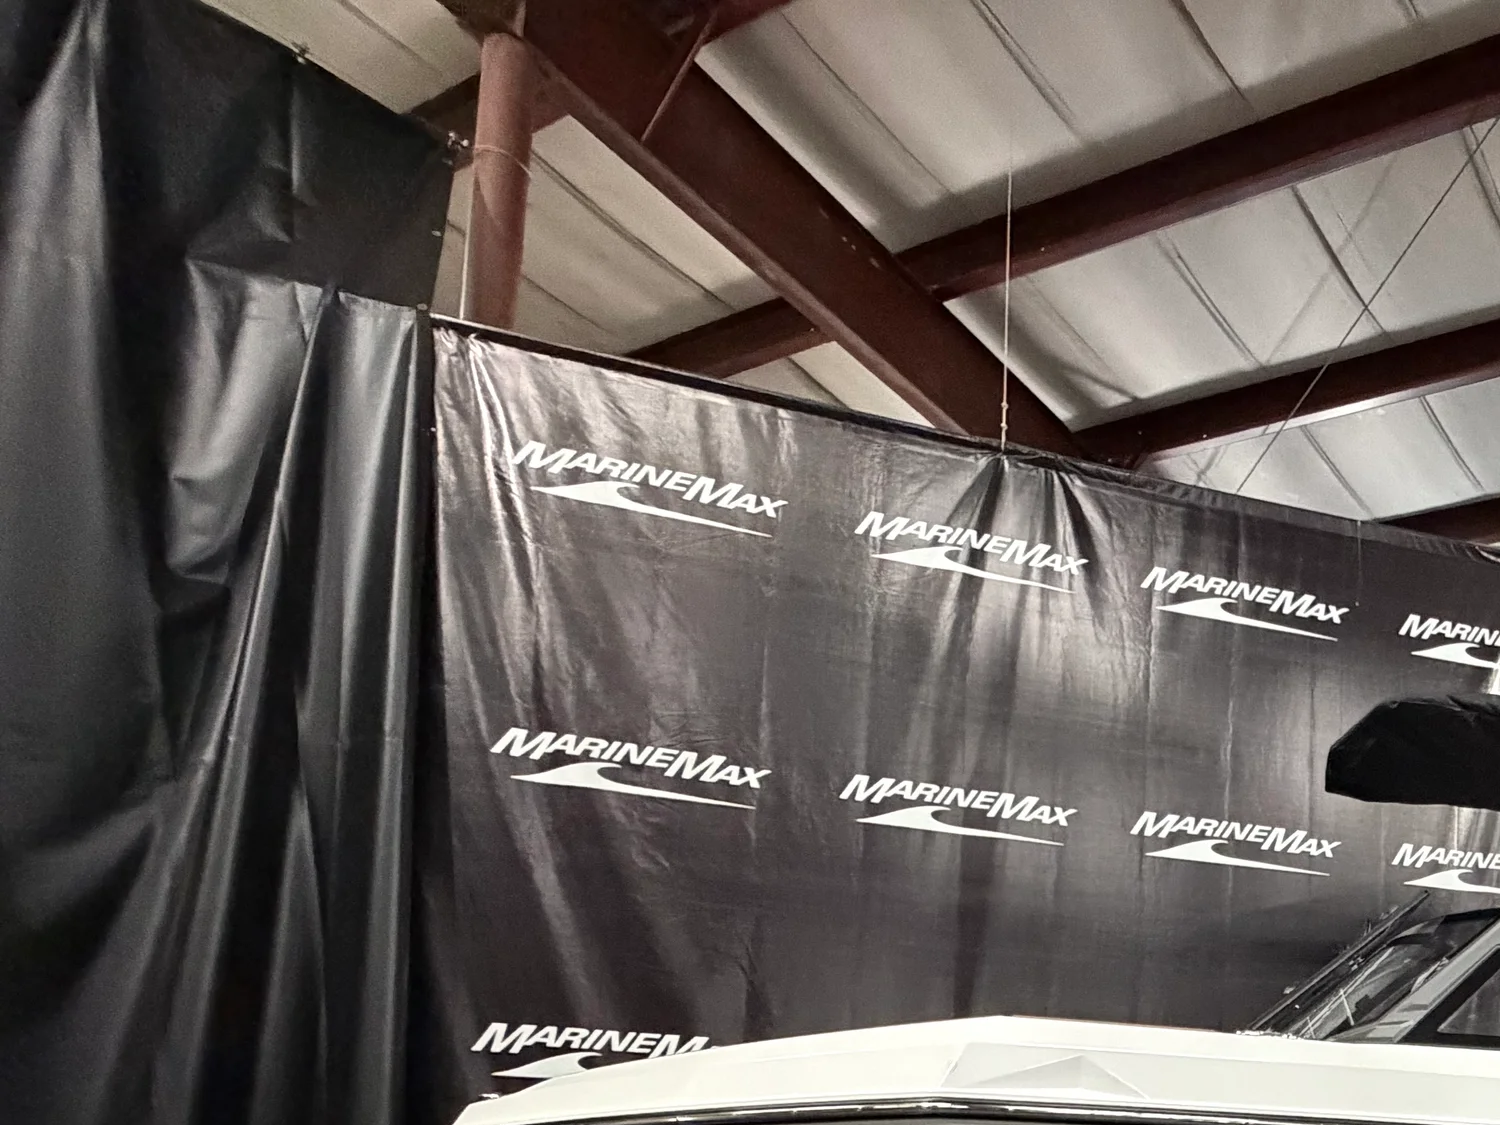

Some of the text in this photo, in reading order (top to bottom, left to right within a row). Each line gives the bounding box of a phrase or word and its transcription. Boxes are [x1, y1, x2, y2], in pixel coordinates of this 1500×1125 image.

[511, 439, 788, 519] MARINEMAX
[854, 511, 1088, 576] MARINEMAX
[1140, 566, 1350, 626] MARINEMAX
[490, 727, 772, 790] MARINEMAX
[839, 773, 1078, 828] MARINEMAX
[1130, 810, 1341, 859] MARINEMAX
[470, 1022, 711, 1059] MARINEM
